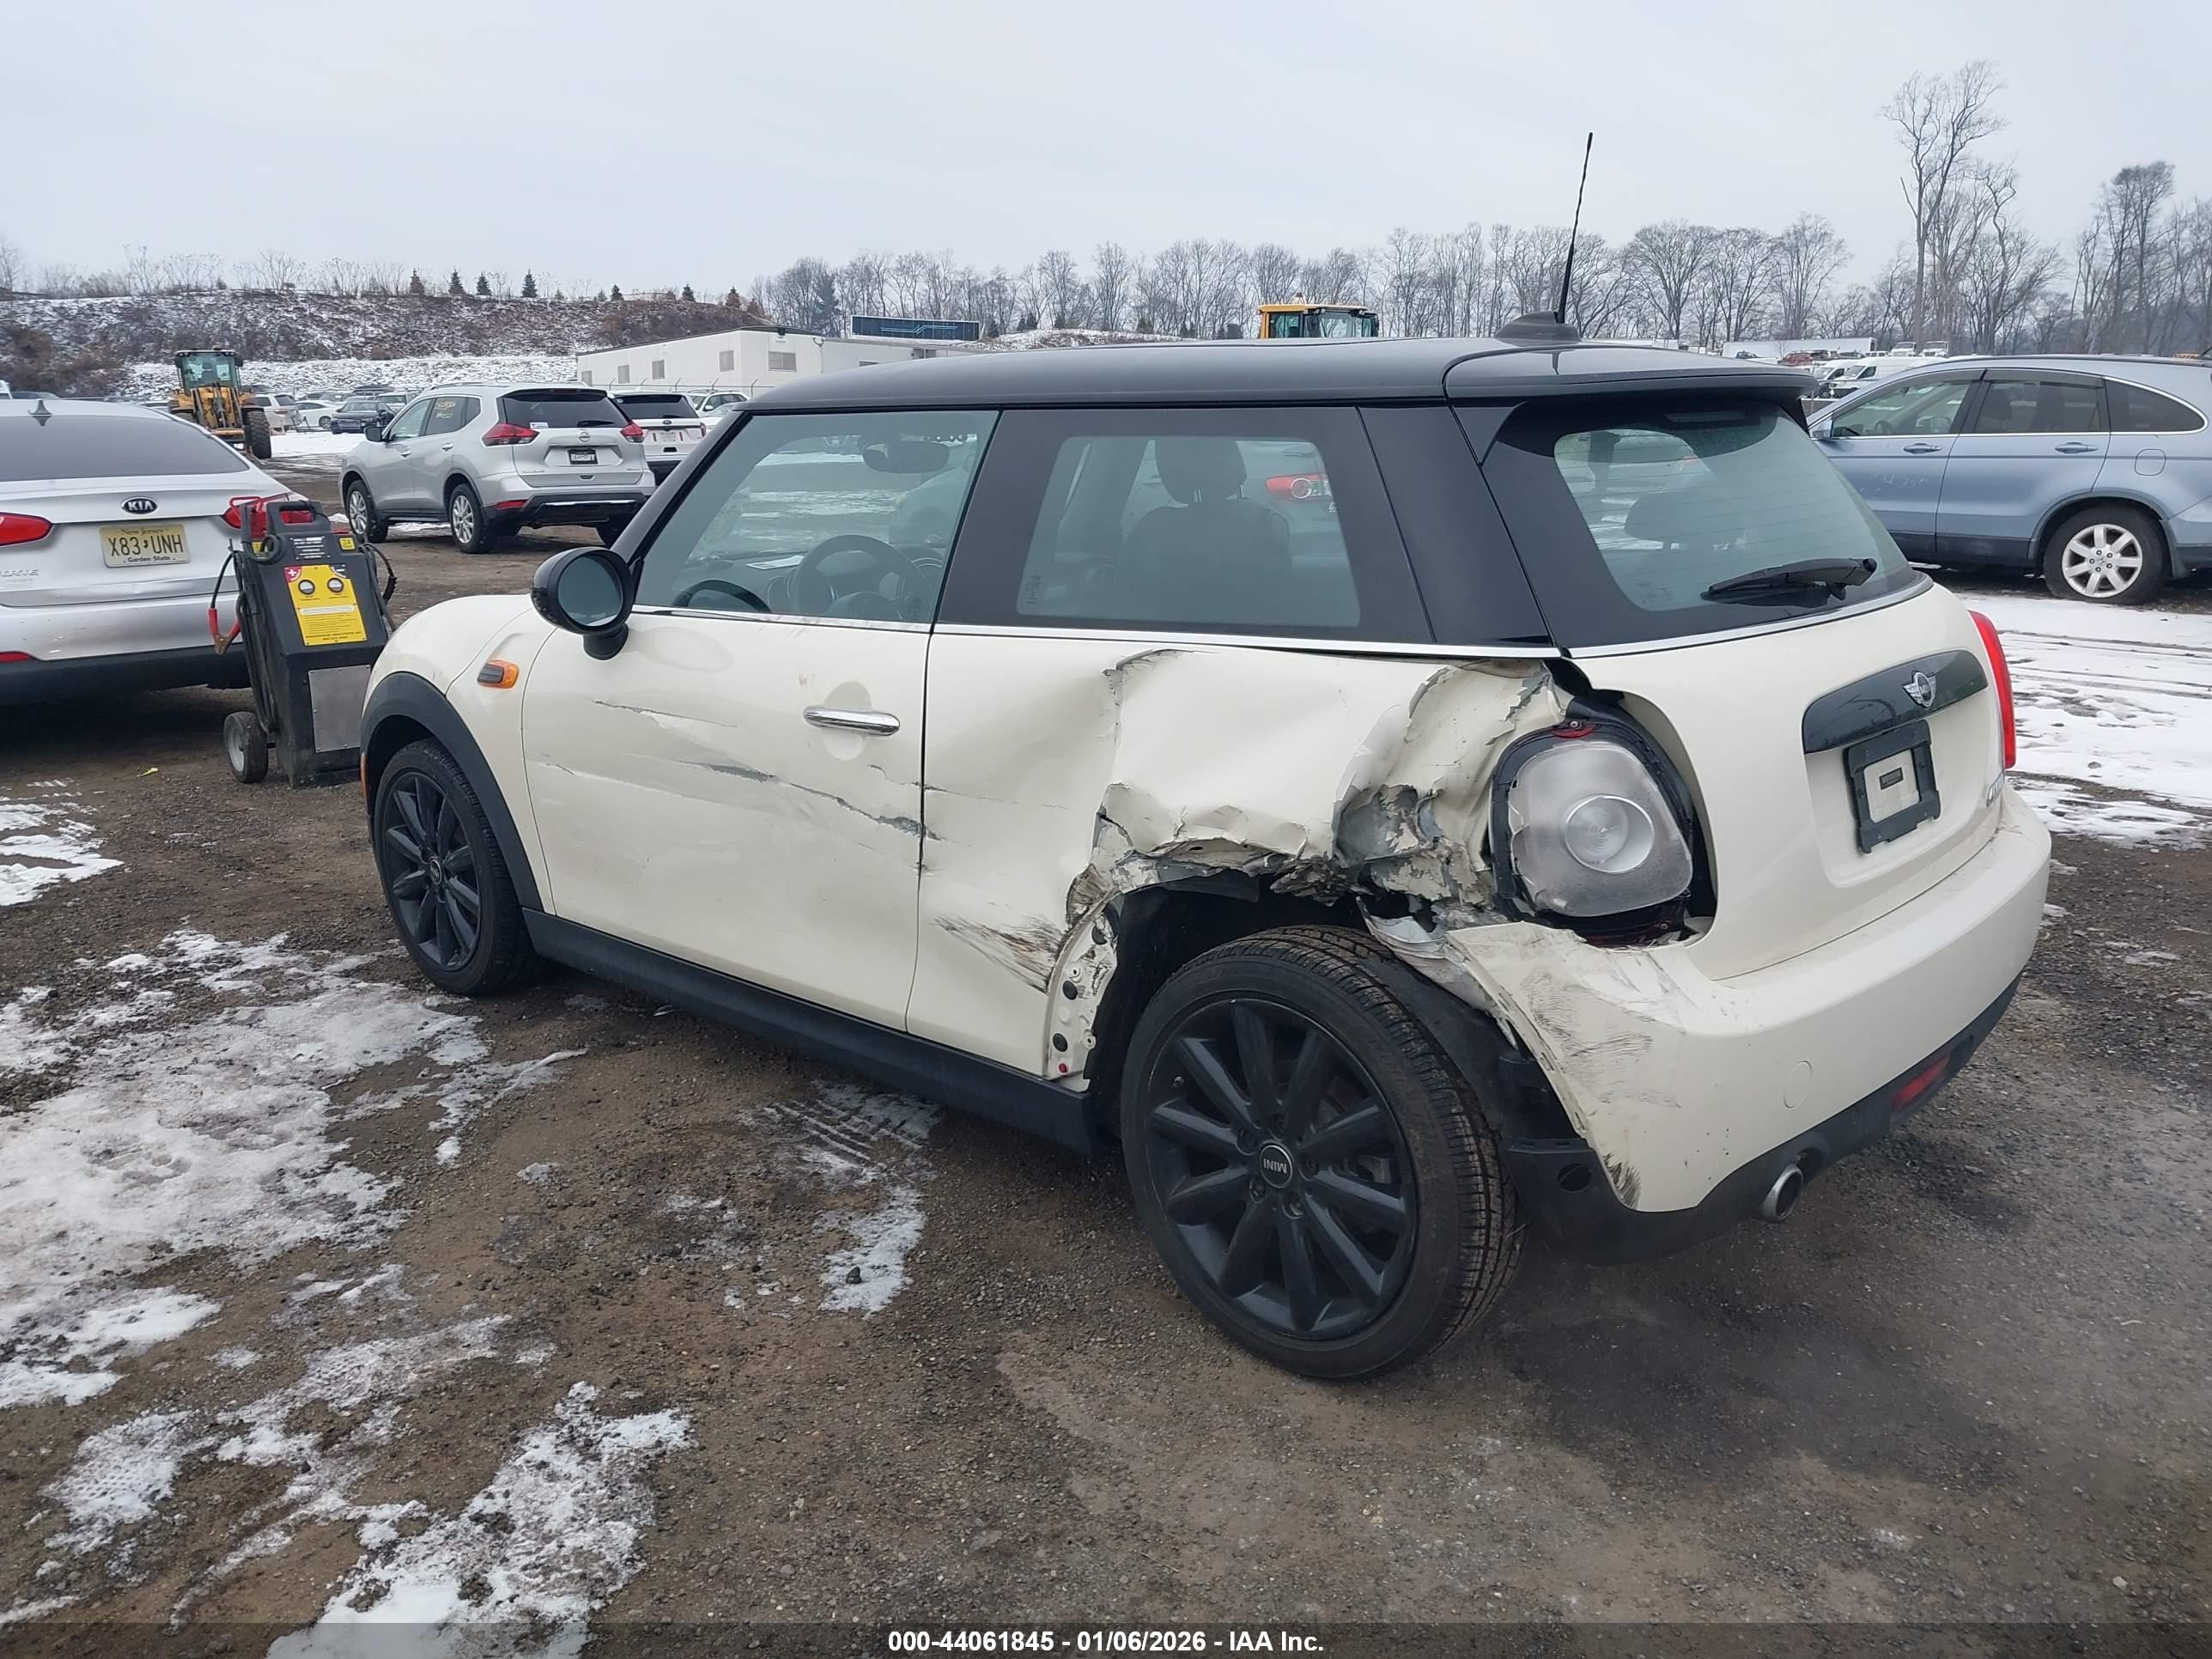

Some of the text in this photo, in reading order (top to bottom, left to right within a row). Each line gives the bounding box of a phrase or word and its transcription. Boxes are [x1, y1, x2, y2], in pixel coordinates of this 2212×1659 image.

[128, 501, 154, 511] KIA
[108, 534, 184, 556] X83 UNH
[1263, 1158, 1287, 1174] MINI
